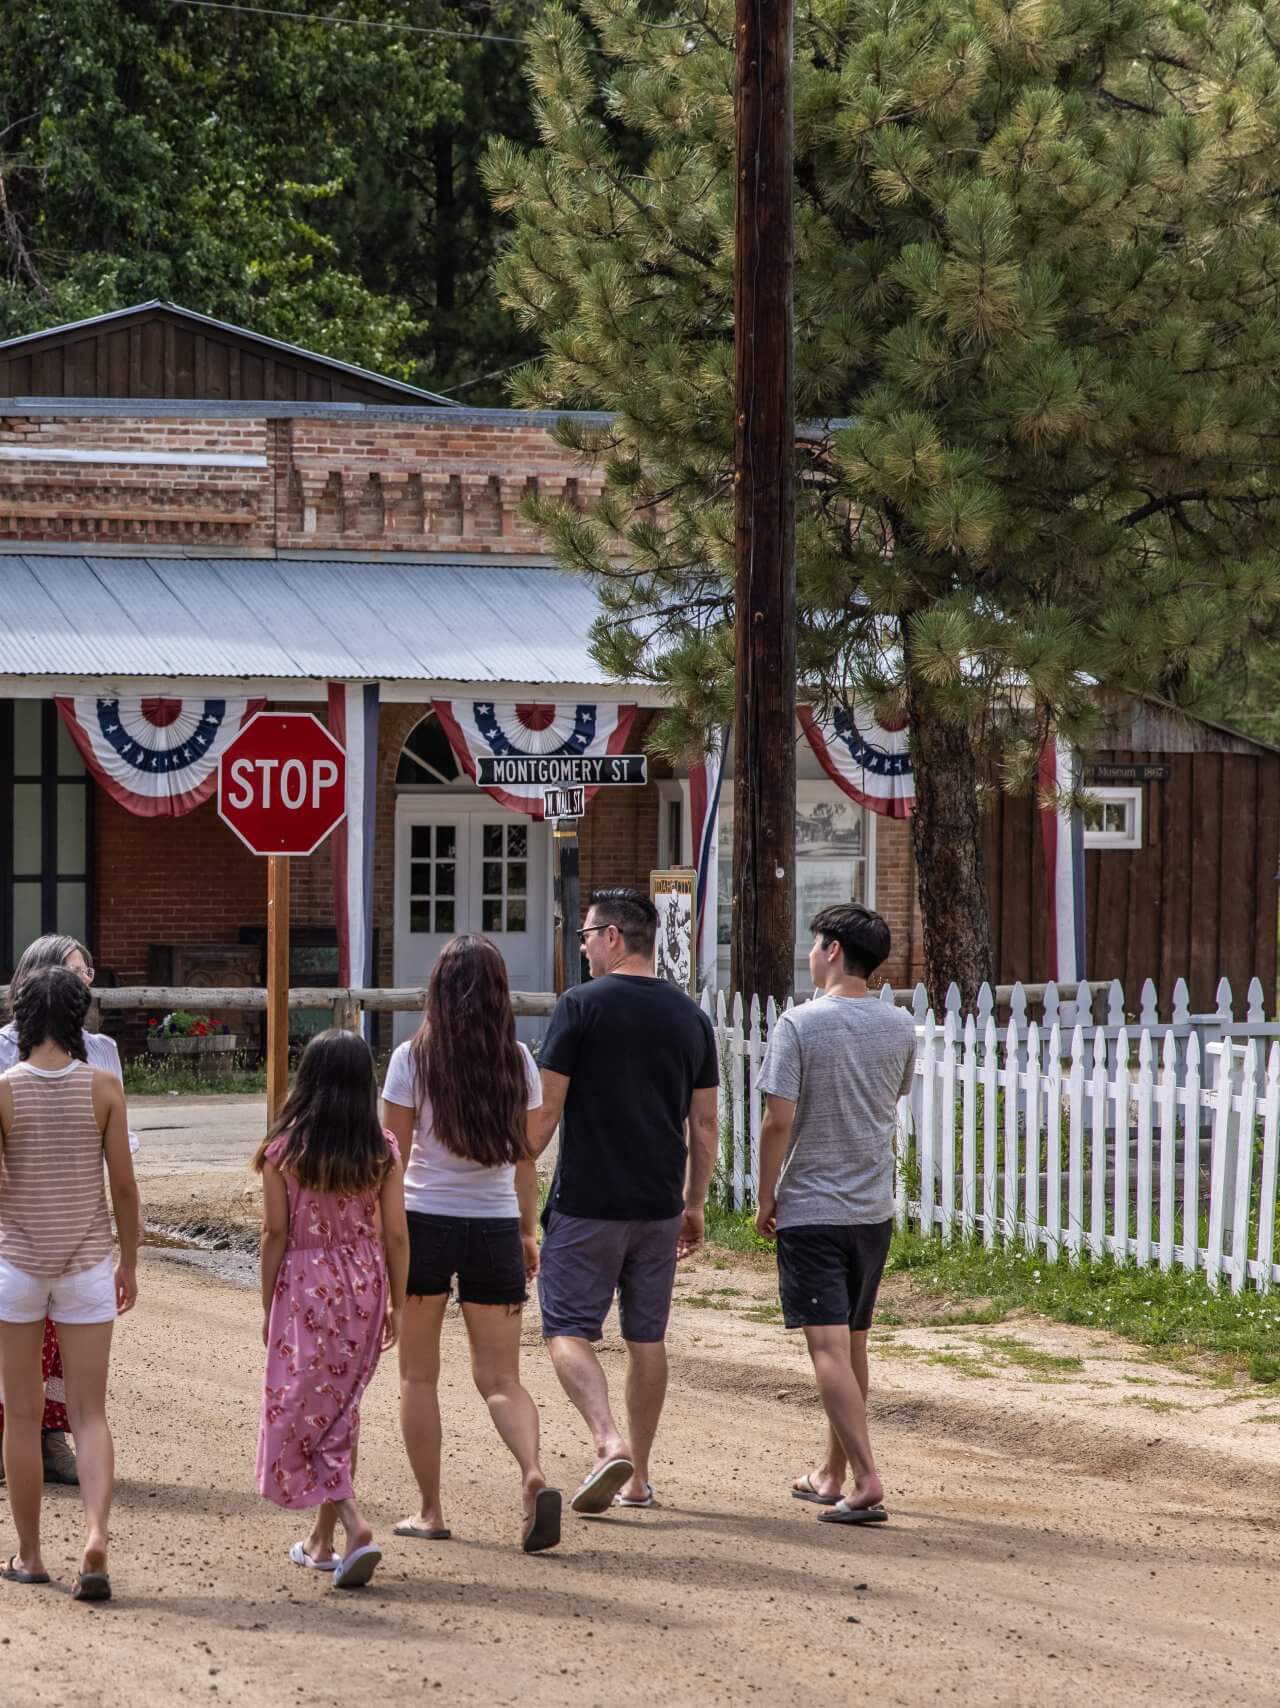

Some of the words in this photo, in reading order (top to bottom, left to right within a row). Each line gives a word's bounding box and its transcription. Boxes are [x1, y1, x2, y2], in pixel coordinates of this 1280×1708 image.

[493, 760, 606, 783] MONTGOMERY
[612, 760, 630, 781] ST
[228, 758, 339, 810] STOP
[556, 791, 572, 814] WALL
[573, 790, 581, 813] ST
